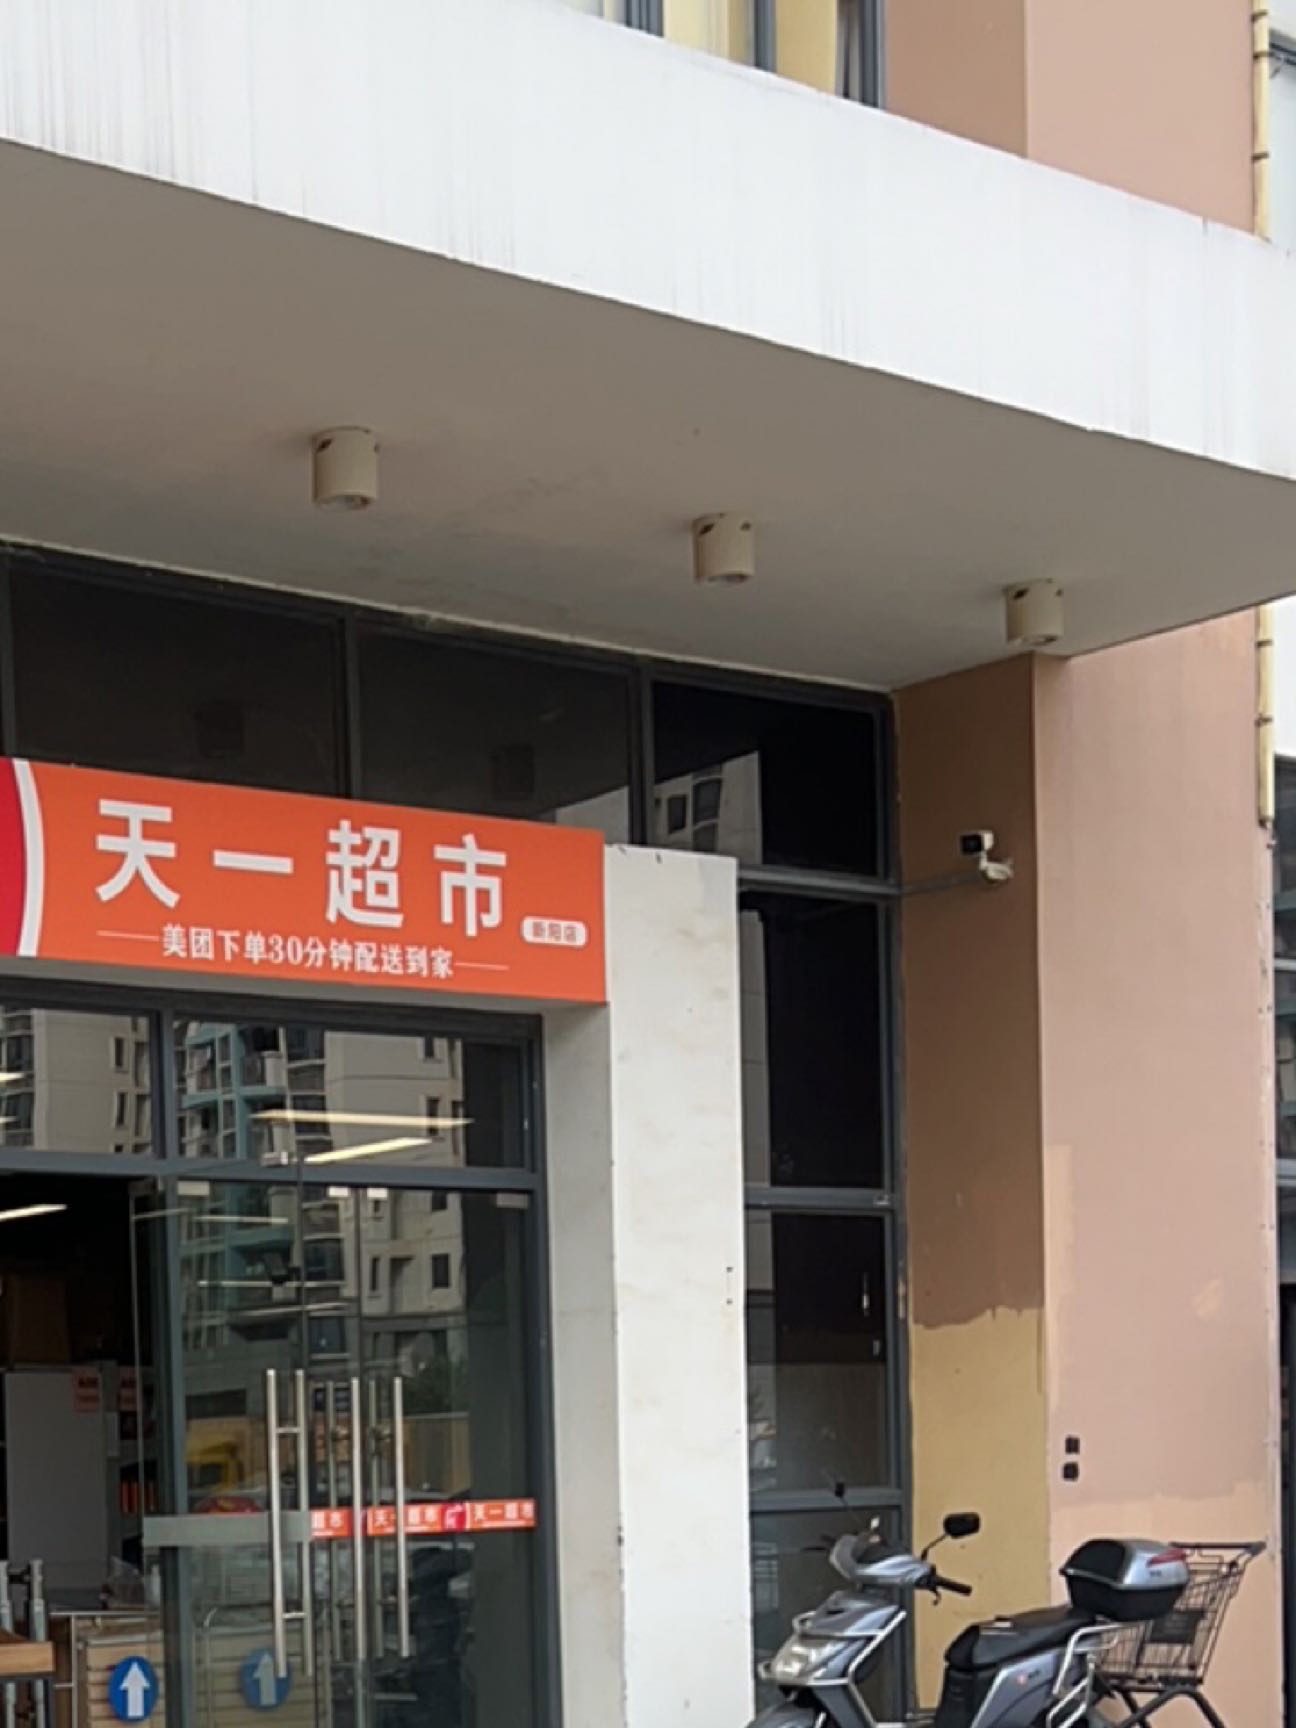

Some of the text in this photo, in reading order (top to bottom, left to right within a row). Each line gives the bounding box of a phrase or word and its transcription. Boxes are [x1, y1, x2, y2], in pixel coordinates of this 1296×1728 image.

[95, 798, 507, 938] 天一超市
[161, 923, 454, 979] 美团下单30分钟配送到家
